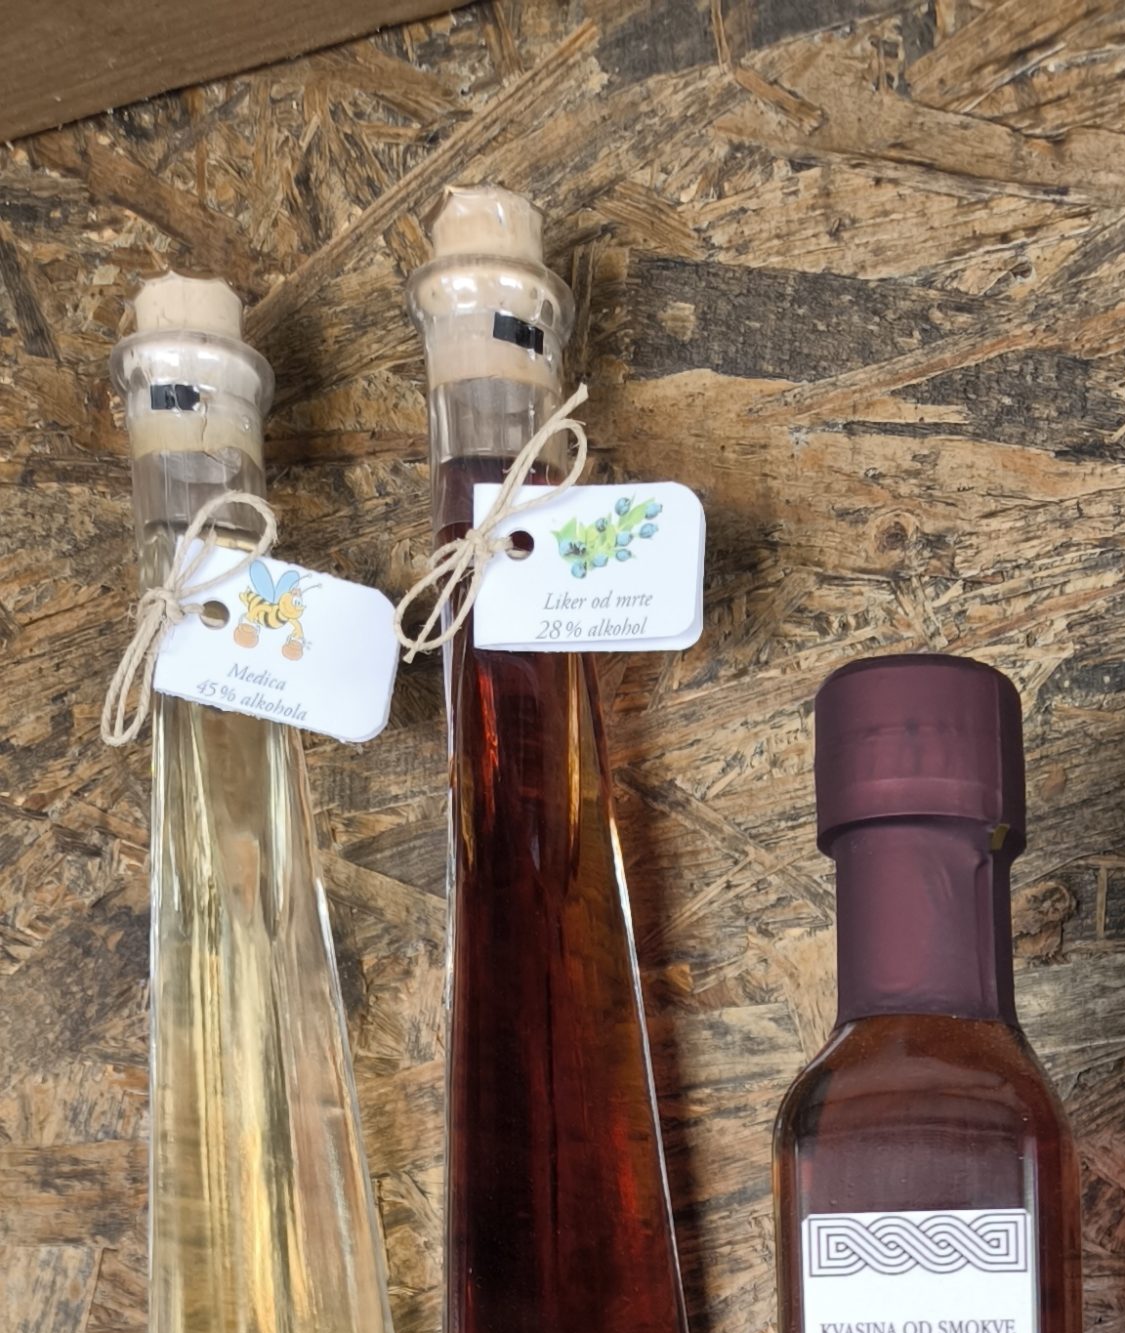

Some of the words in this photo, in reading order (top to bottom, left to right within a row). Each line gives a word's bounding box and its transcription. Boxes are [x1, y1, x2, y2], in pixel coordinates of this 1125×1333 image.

[543, 592, 587, 610] Liker
[591, 590, 613, 609] od
[616, 593, 654, 608] mrte
[587, 616, 648, 637] alkohol
[227, 663, 287, 691] Medica
[240, 692, 309, 721] alkohola
